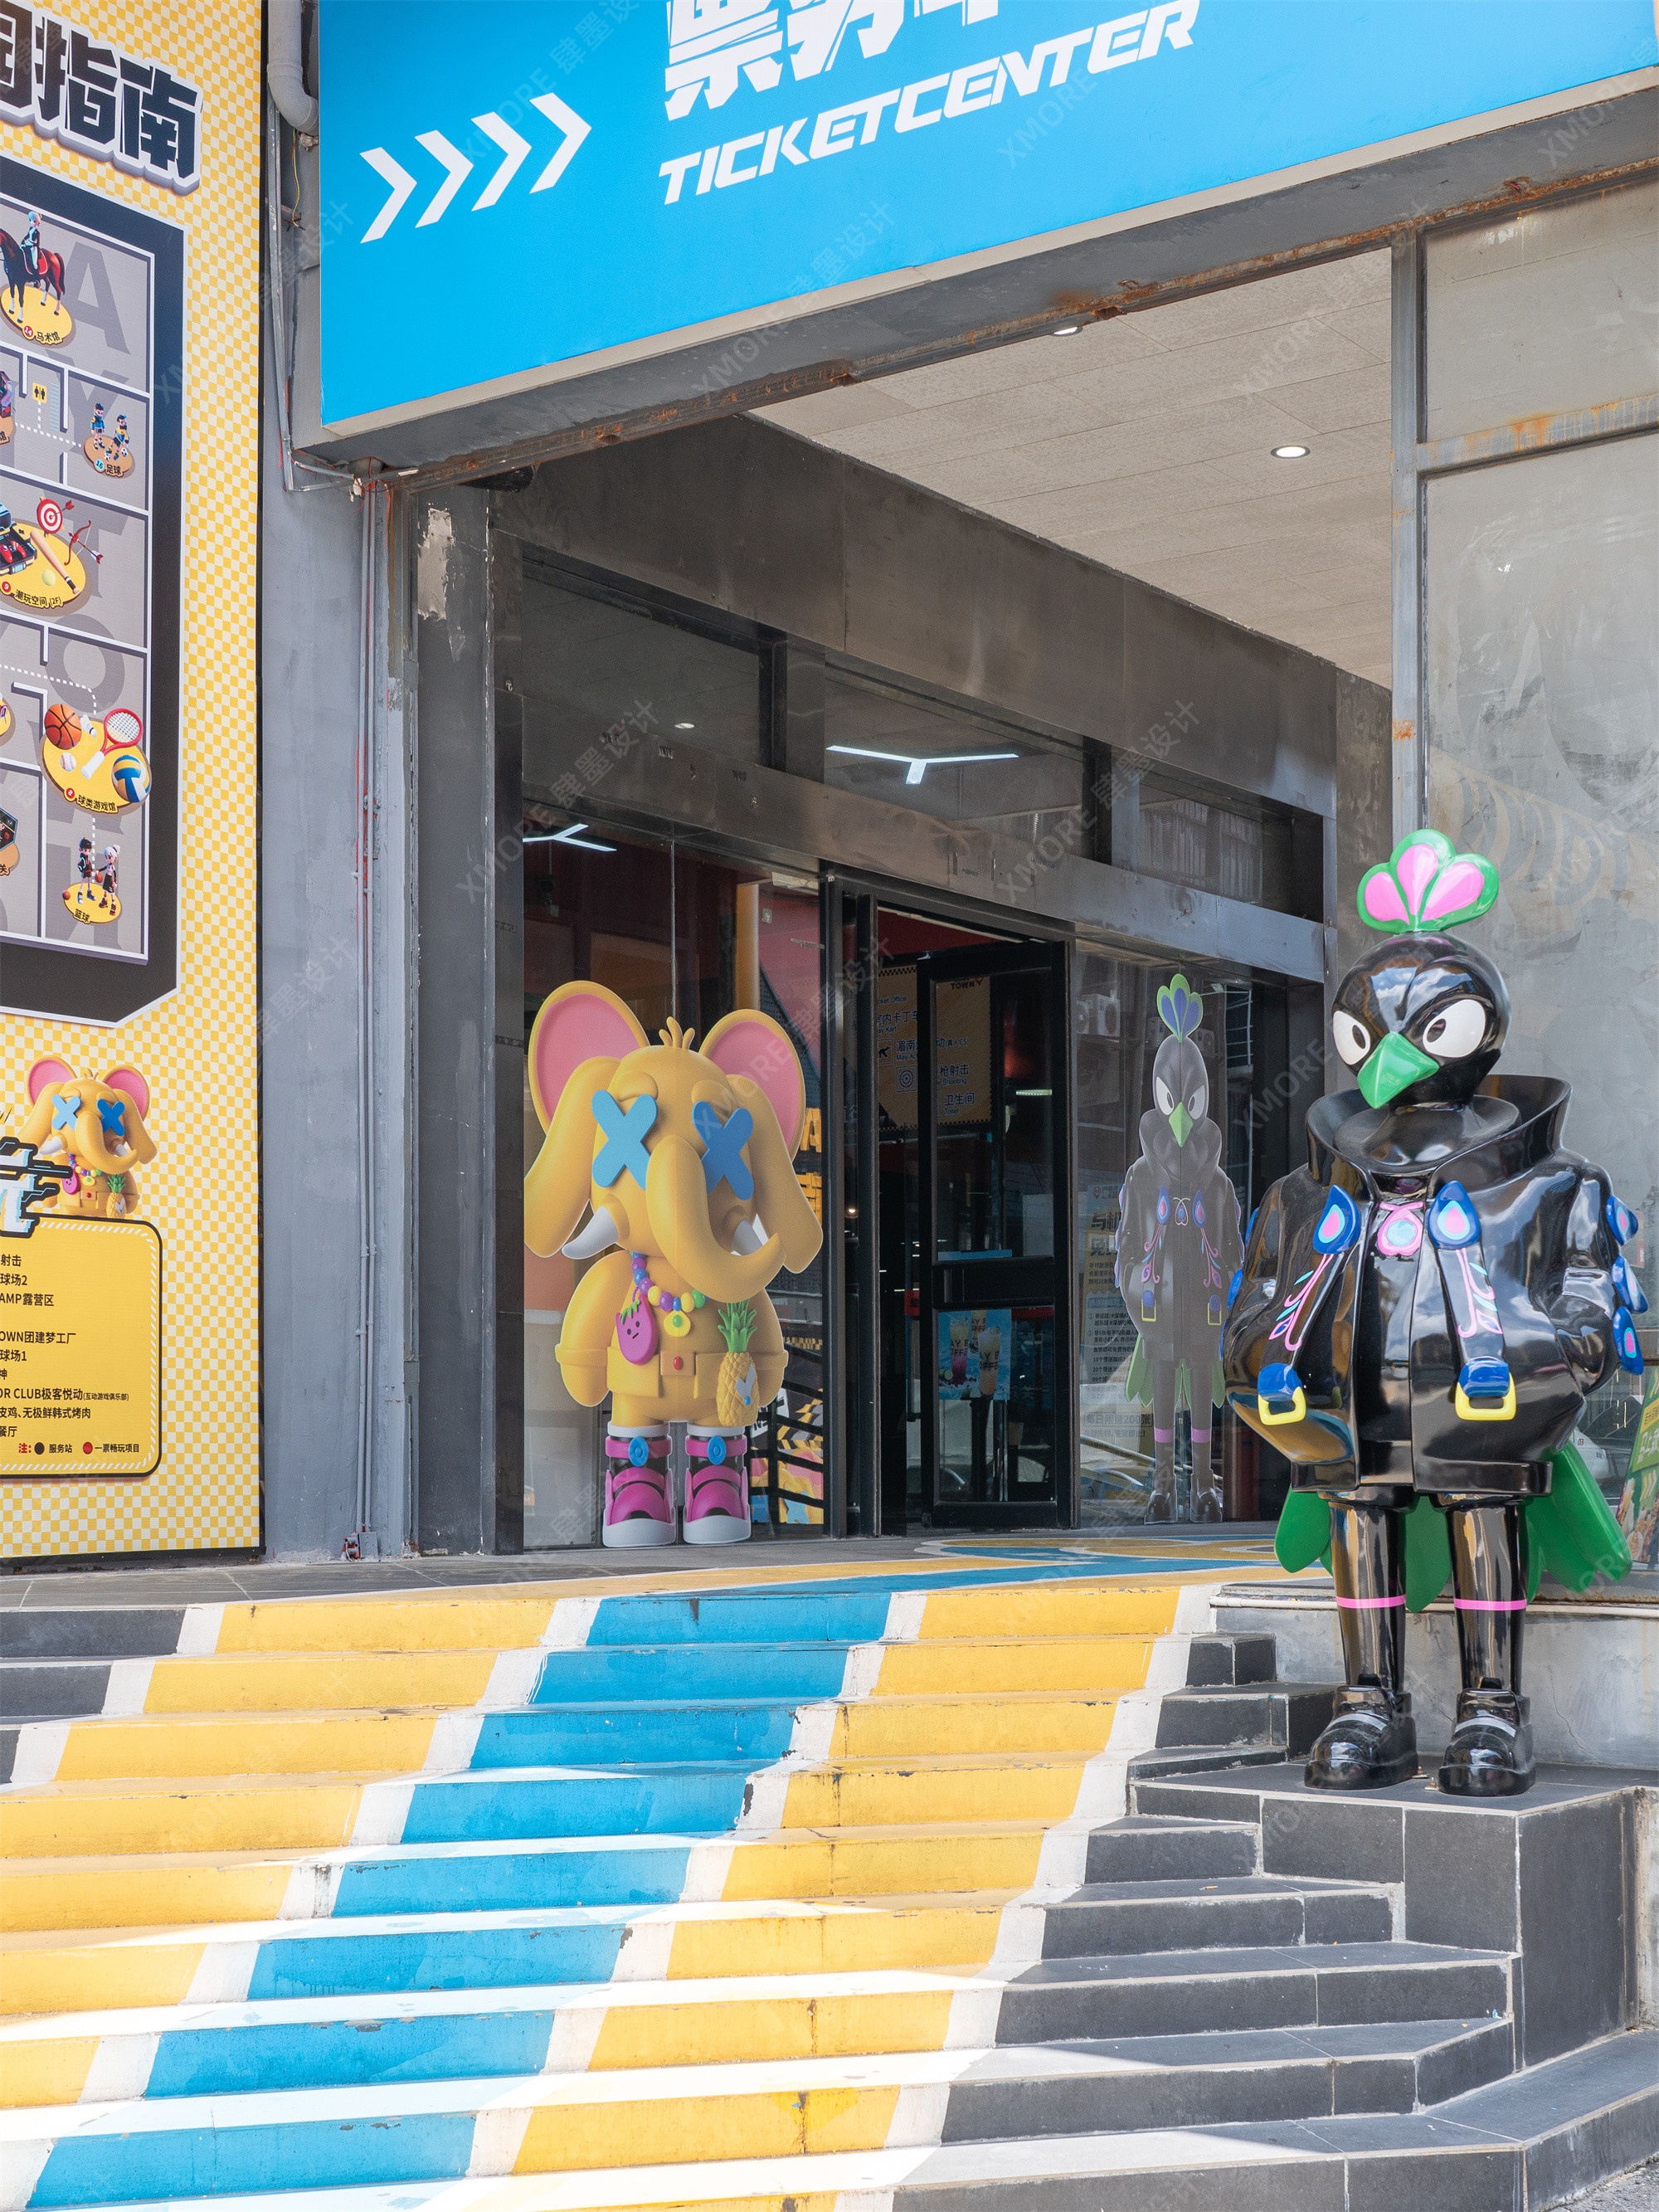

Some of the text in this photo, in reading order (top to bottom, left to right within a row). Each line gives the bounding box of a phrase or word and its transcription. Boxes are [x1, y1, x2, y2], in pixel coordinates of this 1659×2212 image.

[665, 0, 998, 122] 票务
[658, 0, 1200, 206] TICKETCENTER
[36, 331, 61, 343] 马术馆
[106, 464, 121, 475] 足球
[15, 588, 47, 607] 潮玩空间
[77, 794, 117, 812] 球类游戏馆
[75, 909, 90, 923] 篮球
[951, 982, 975, 990] TOWN
[896, 1040, 917, 1052] 湄南
[937, 1064, 969, 1077] 枪射击
[944, 1092, 975, 1106] 卫生间
[0, 1274, 27, 1286] 球场2
[49, 1444, 73, 1454] 服务站
[95, 1444, 139, 1454] 一票畅玩项目
